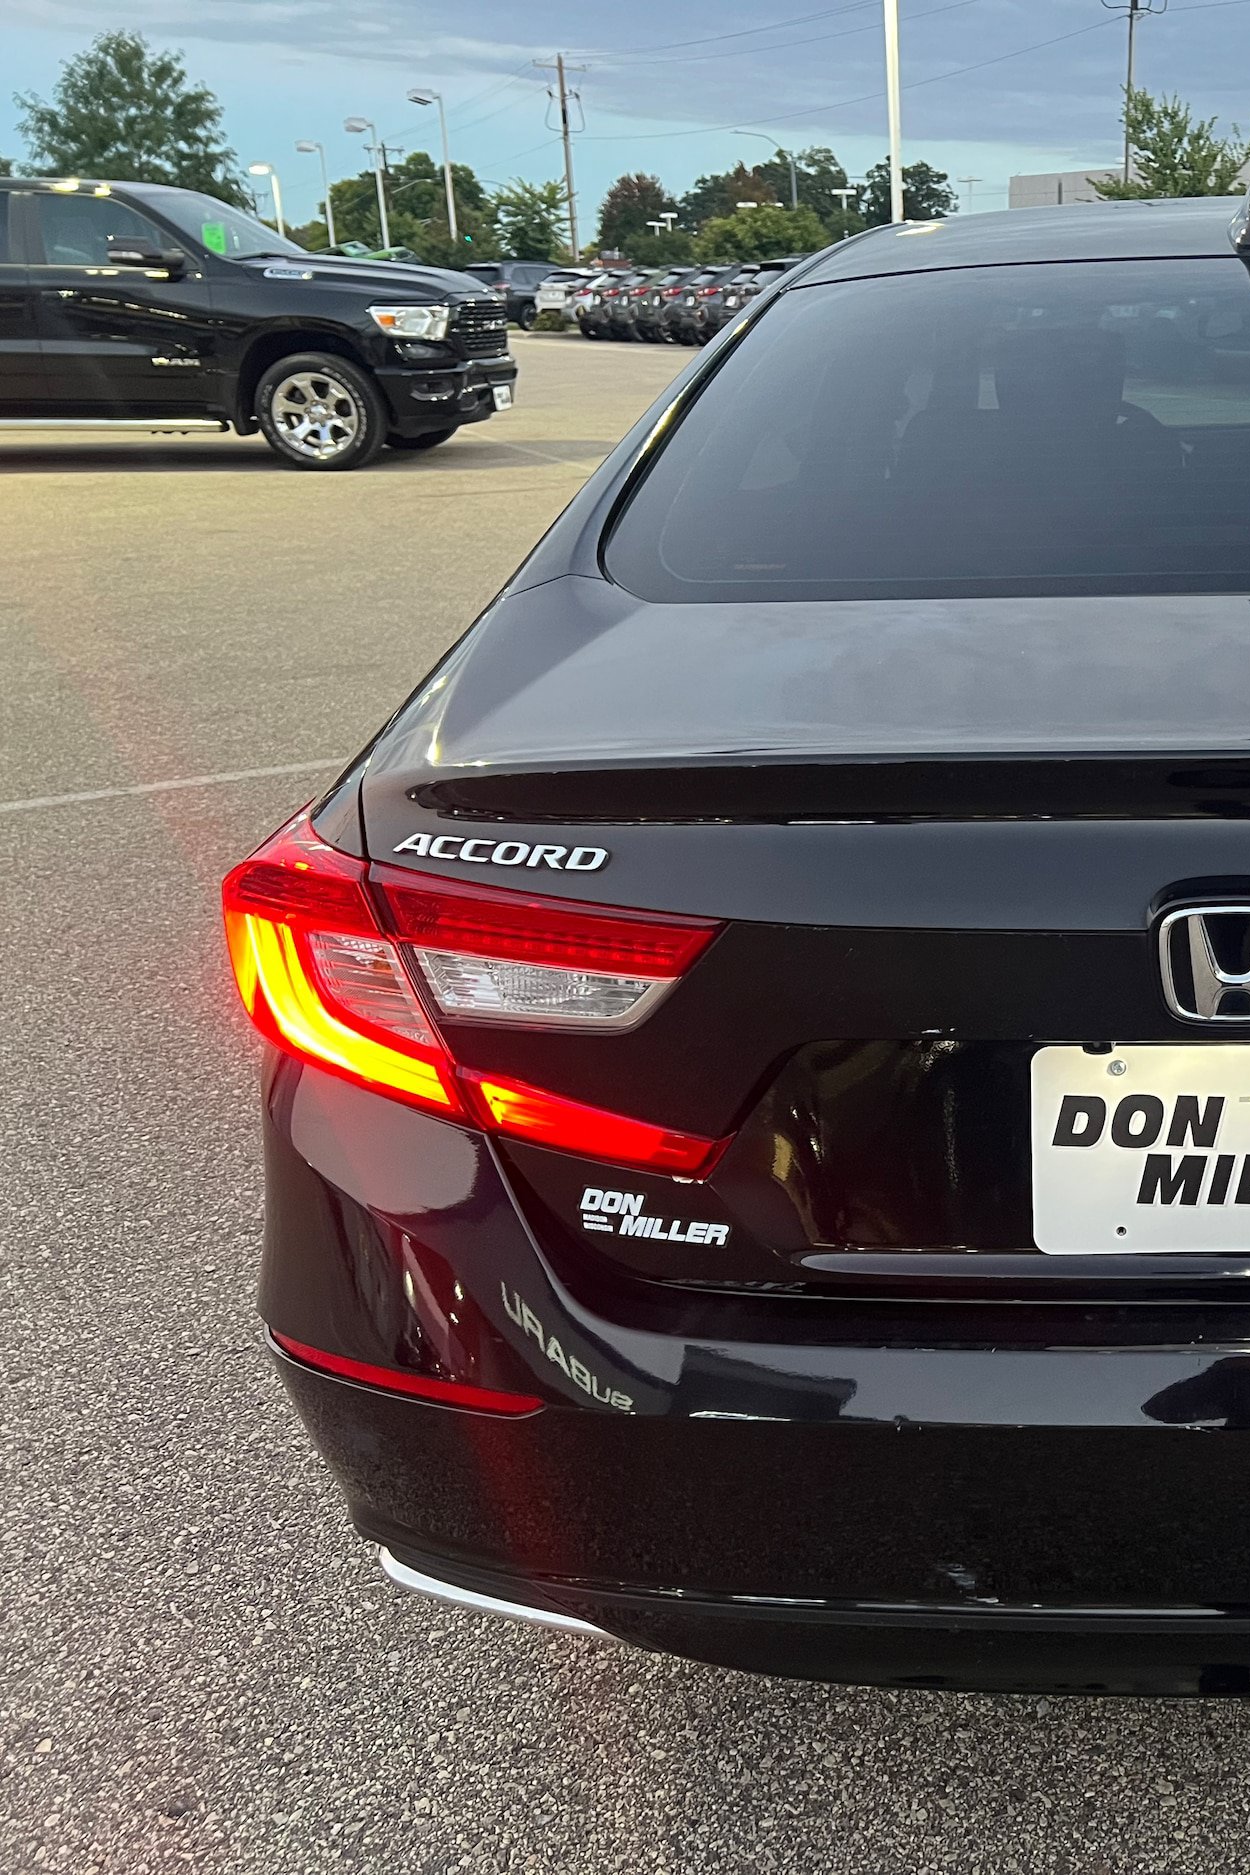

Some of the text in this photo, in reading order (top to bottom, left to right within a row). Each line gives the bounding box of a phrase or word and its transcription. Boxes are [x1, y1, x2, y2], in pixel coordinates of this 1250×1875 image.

[392, 832, 610, 871] ACCORD
[1051, 1094, 1226, 1148] DON
[579, 1187, 645, 1216] DON
[618, 1214, 730, 1246] MILLER
